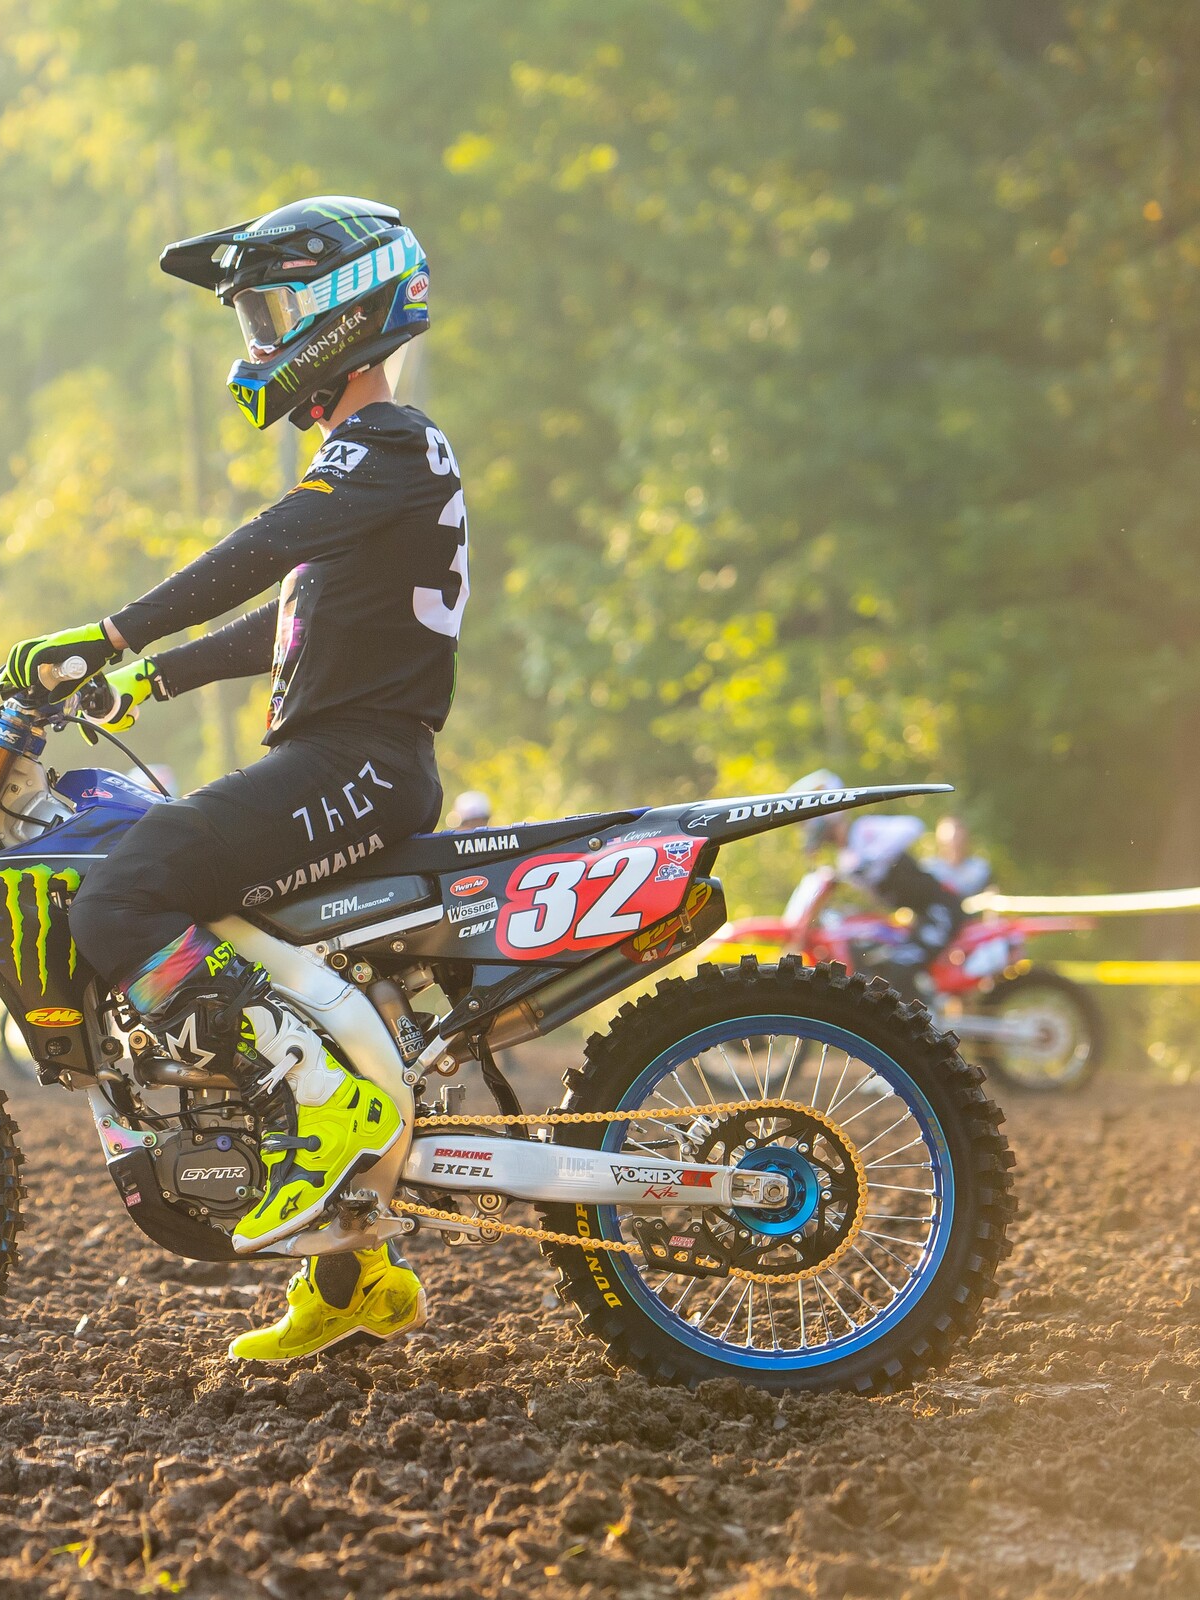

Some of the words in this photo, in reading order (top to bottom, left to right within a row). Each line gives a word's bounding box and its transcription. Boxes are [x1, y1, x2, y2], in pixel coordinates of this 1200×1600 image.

[410, 278, 428, 297] BELL
[726, 788, 869, 824] DUNLOP
[453, 834, 519, 855] YAMAHA
[623, 829, 661, 845] Cooper
[275, 833, 385, 897] YAMAHA
[455, 883, 473, 892] Twin
[473, 879, 485, 887] Air
[506, 846, 657, 949] 32
[28, 1010, 82, 1021] FMF
[434, 1148, 493, 1161] BRAKING
[181, 1166, 246, 1180] GYTR
[432, 1163, 494, 1178] EXCEL
[611, 1166, 683, 1185] VORTEX
